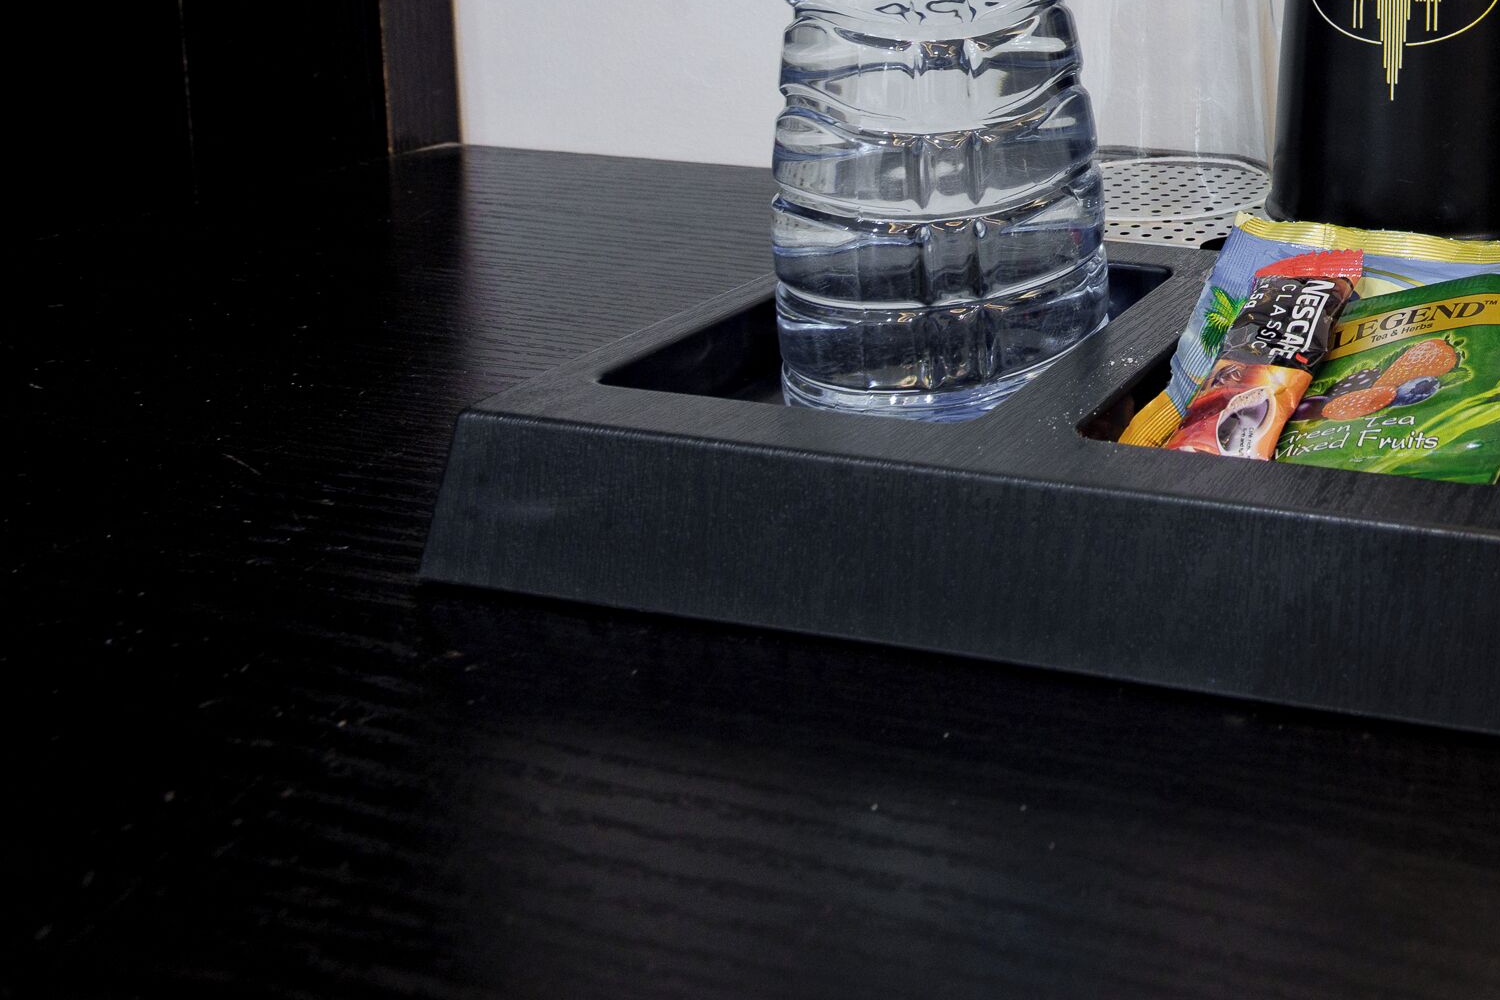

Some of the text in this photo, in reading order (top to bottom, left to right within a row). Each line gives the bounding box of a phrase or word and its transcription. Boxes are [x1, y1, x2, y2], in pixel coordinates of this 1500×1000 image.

[1251, 283, 1297, 349] CLASSIC
[1371, 333, 1388, 343] Tea
[1401, 322, 1433, 335] Herbs
[1364, 415, 1416, 428] Tea
[1357, 428, 1439, 450] Fruits
